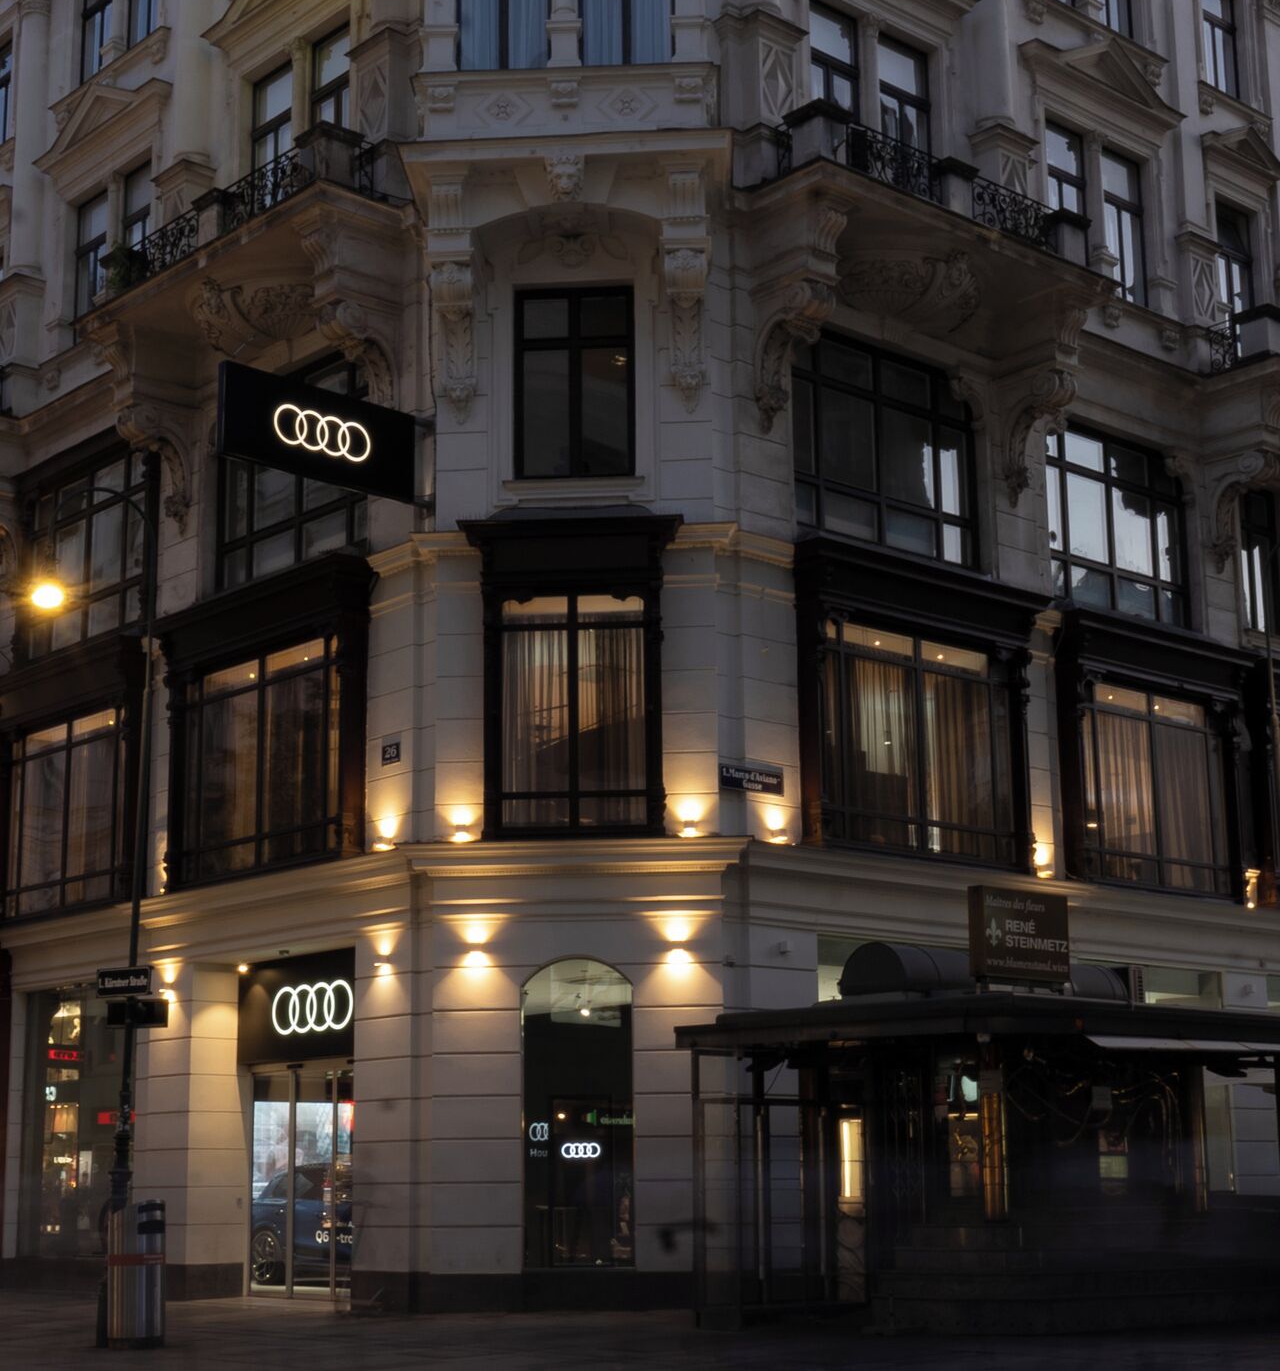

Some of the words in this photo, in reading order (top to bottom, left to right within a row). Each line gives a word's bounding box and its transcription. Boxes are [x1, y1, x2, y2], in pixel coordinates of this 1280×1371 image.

[384, 745, 397, 758] 26
[742, 779, 763, 791] Gasse
[1012, 897, 1025, 911] des
[1024, 898, 1046, 914] fleurs
[1005, 918, 1036, 934] RENÉ
[1005, 935, 1068, 953] STEINMETZ
[315, 1230, 330, 1244] Q6
